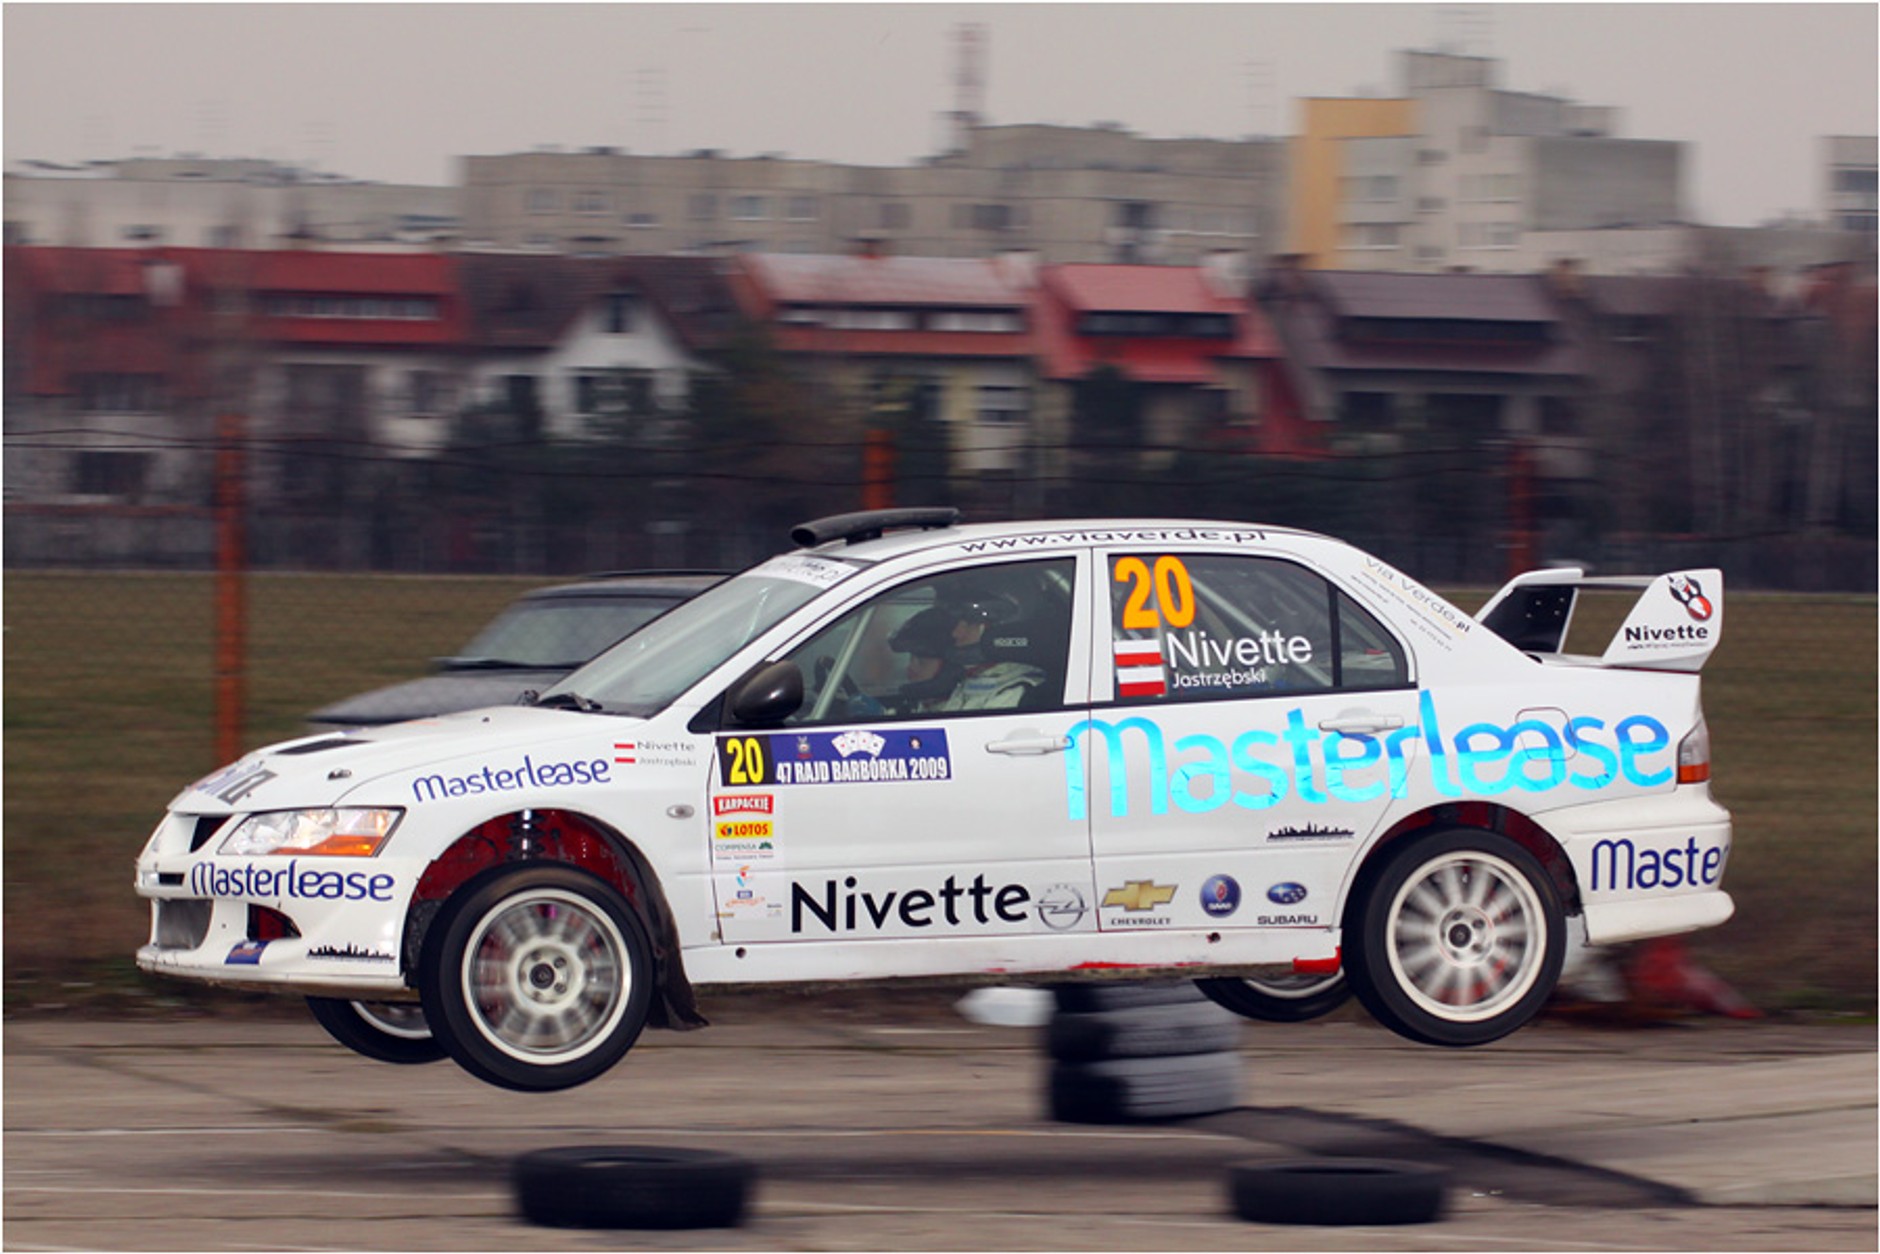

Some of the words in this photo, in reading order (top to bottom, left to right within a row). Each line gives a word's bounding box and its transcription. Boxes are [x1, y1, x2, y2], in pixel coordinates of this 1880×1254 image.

[961, 528, 1267, 552] www.viaverde.pl
[1113, 555, 1197, 629] 20
[1625, 625, 1708, 642] Nivette
[1166, 630, 1312, 669] Nivette
[637, 741, 695, 751] Nivette
[726, 738, 764, 784] 20
[776, 762, 792, 784] 47
[794, 760, 830, 783] RAJD
[831, 756, 908, 782] BARBÓRKA
[909, 756, 949, 779] 2009
[734, 823, 769, 837] LOTOS
[791, 873, 1031, 933] Nivette
[1111, 917, 1172, 926] CHEVROLET
[1257, 915, 1318, 925] SUBARU
